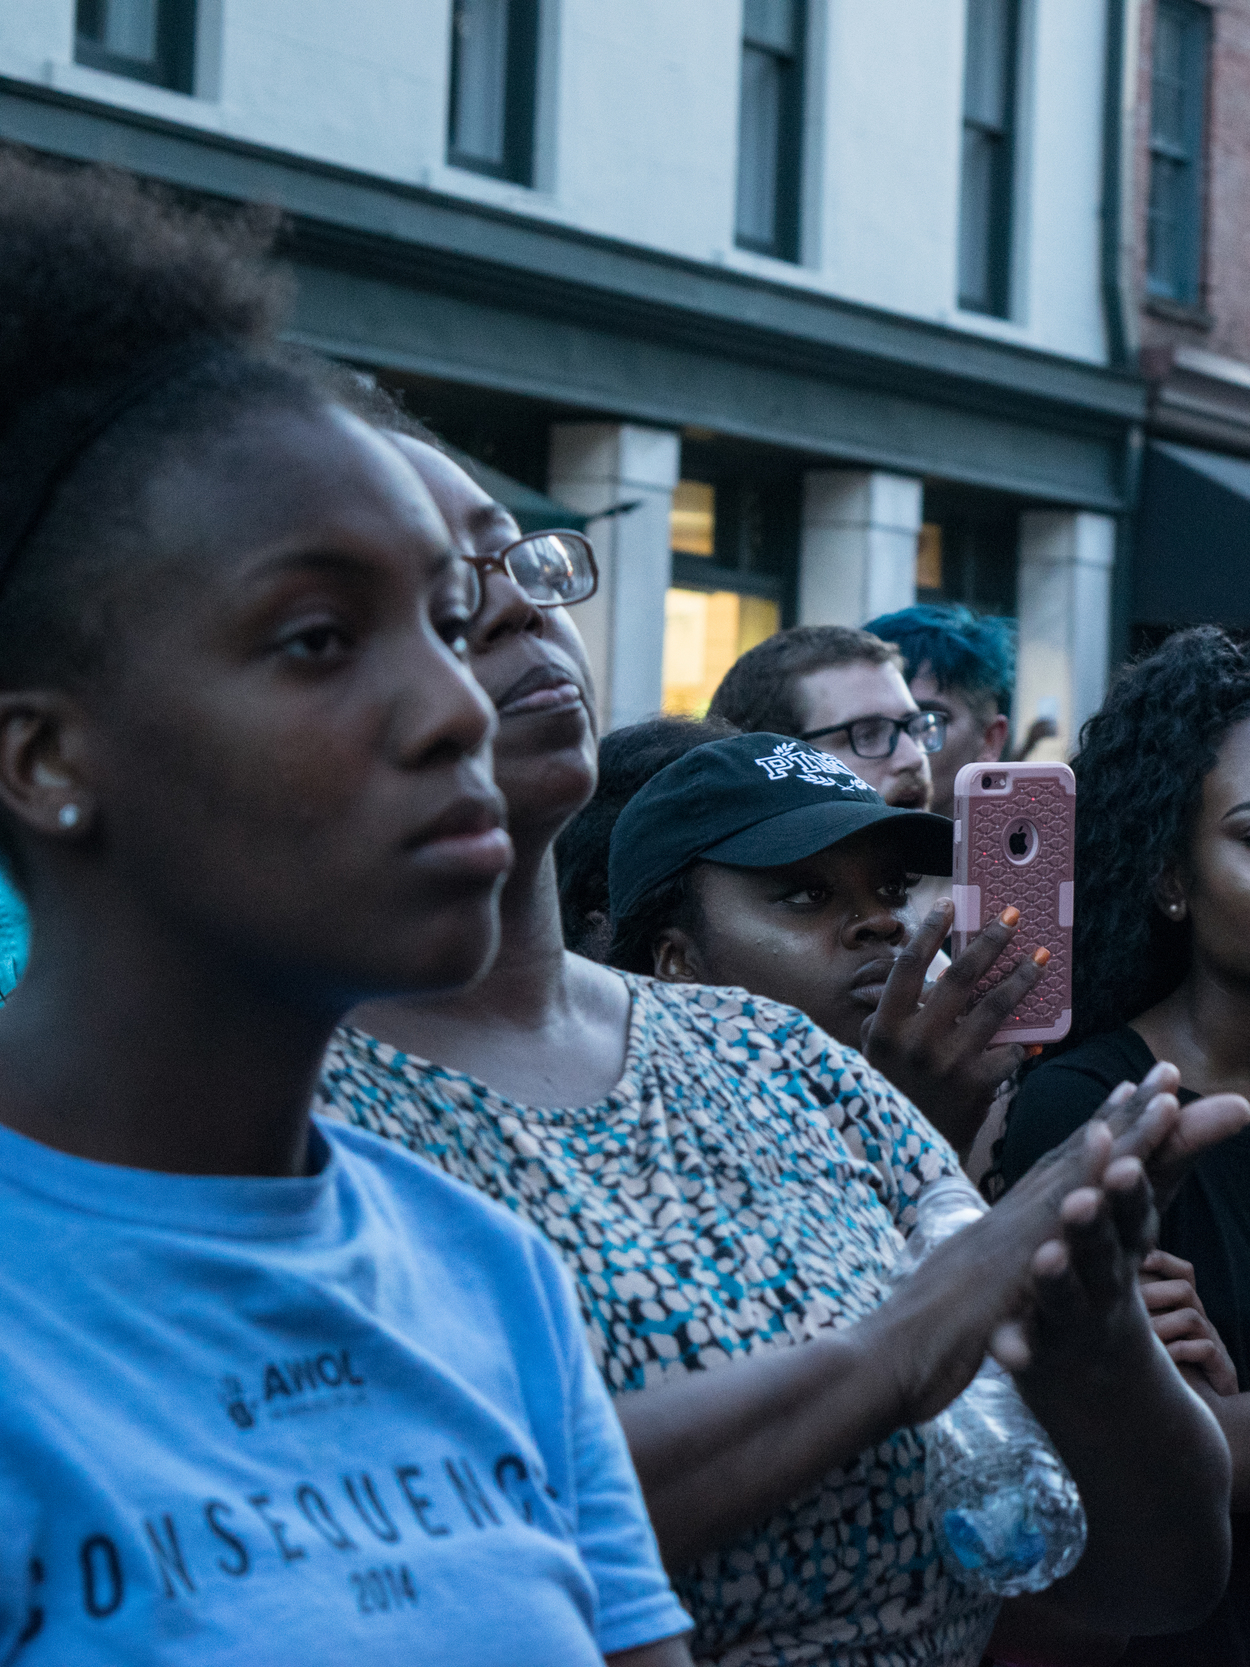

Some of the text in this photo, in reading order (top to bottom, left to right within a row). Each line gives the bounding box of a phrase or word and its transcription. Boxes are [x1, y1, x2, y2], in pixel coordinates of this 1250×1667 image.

[263, 1350, 364, 1401] AWOL
[12, 1453, 558, 1650] ONSEQUENC
[350, 1564, 418, 1613] 2014
